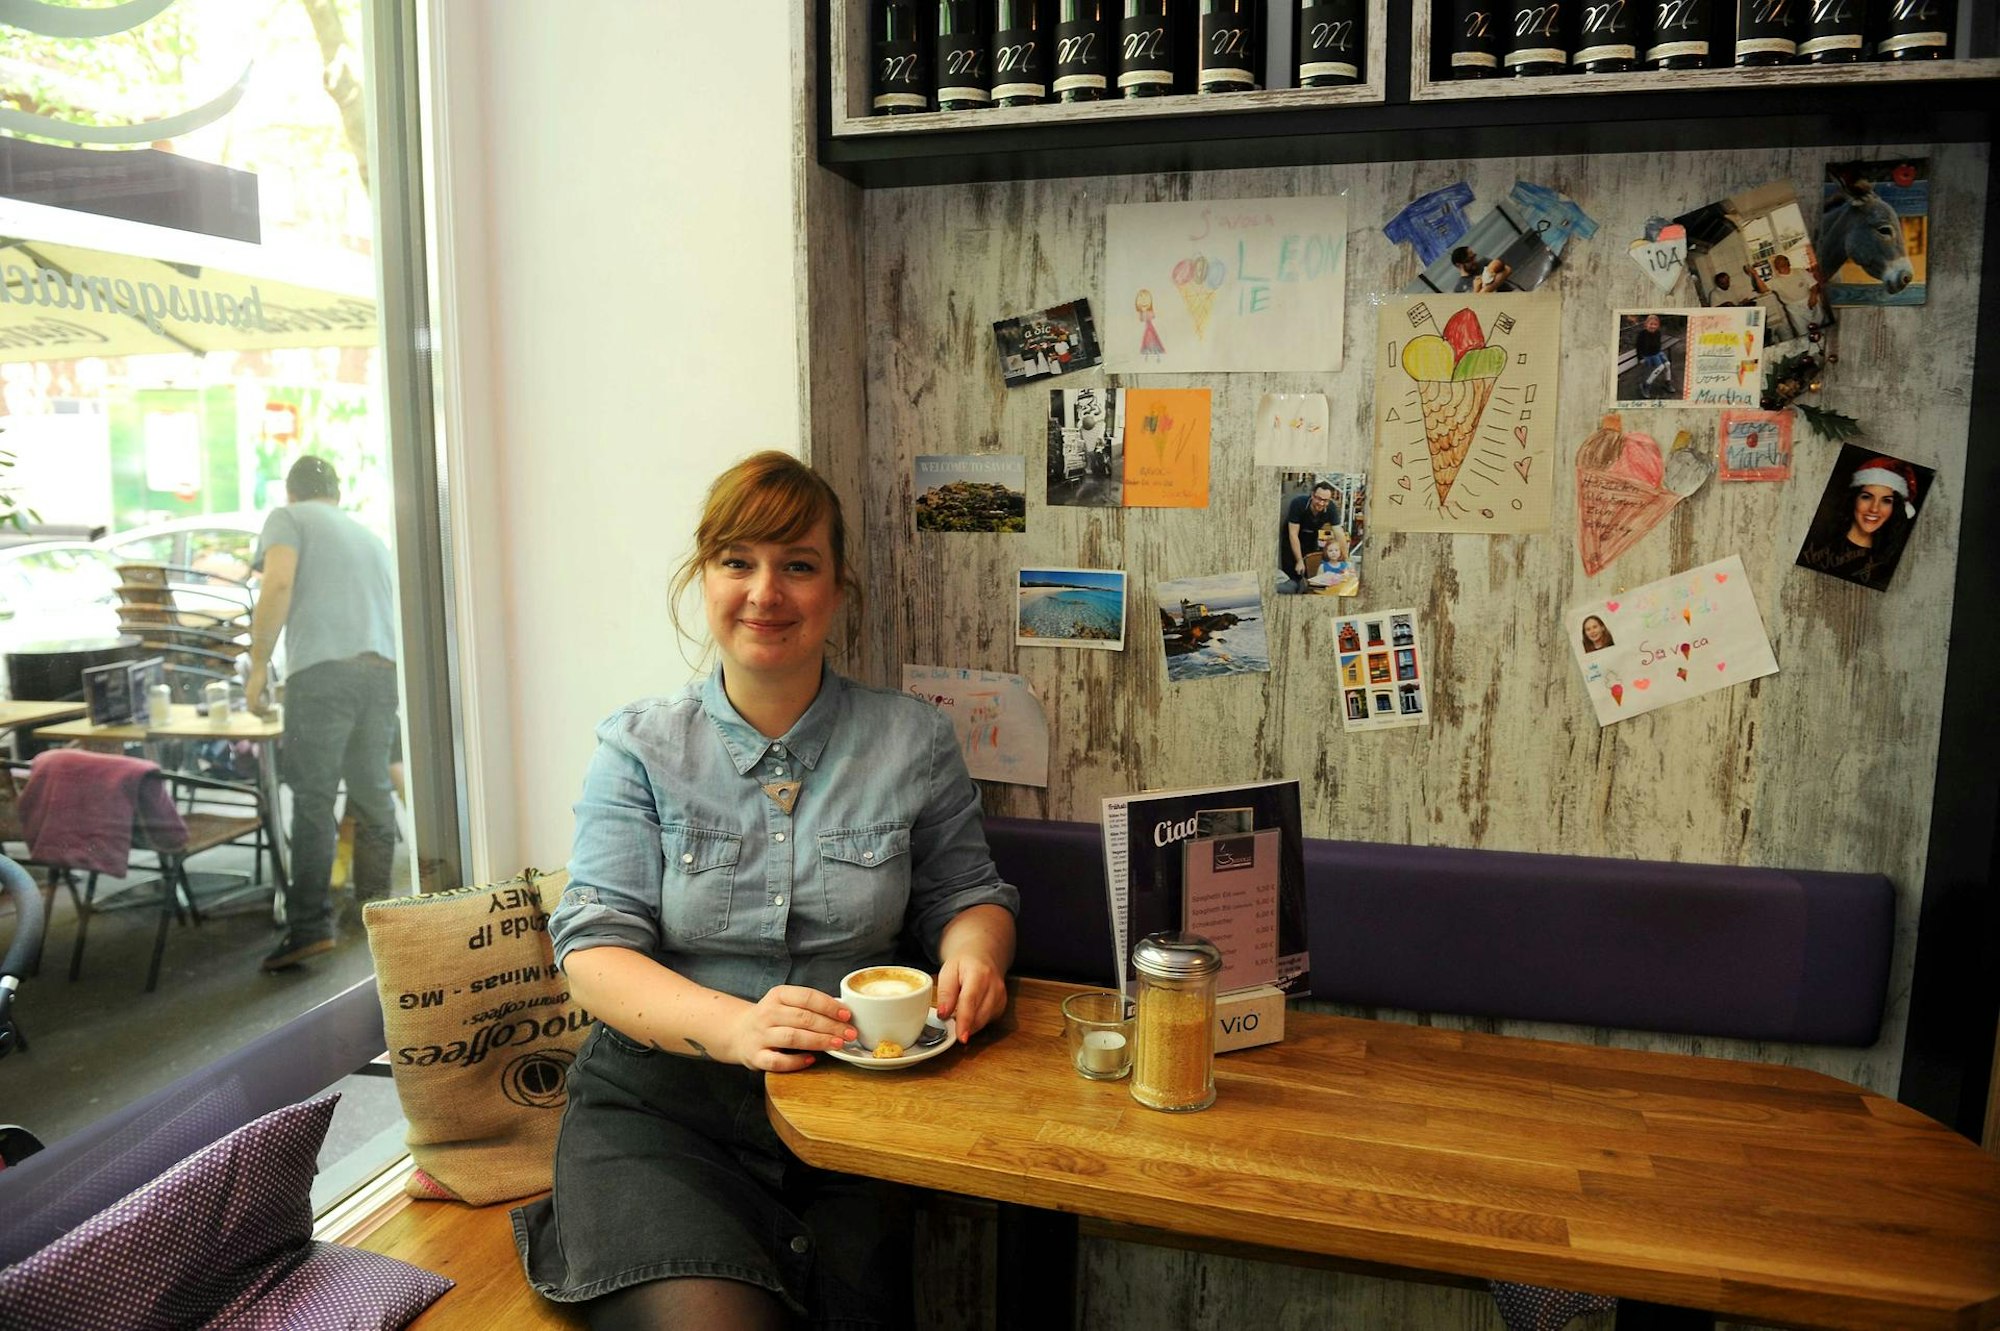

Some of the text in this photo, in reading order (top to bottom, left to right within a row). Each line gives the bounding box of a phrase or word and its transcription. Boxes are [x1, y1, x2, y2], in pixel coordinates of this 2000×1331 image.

[1695, 388, 1753, 406] Martha
[1727, 443, 1790, 470] Martha
[1153, 813, 1198, 848] Ciao
[470, 967, 540, 995] Minas
[399, 990, 443, 1010] MG
